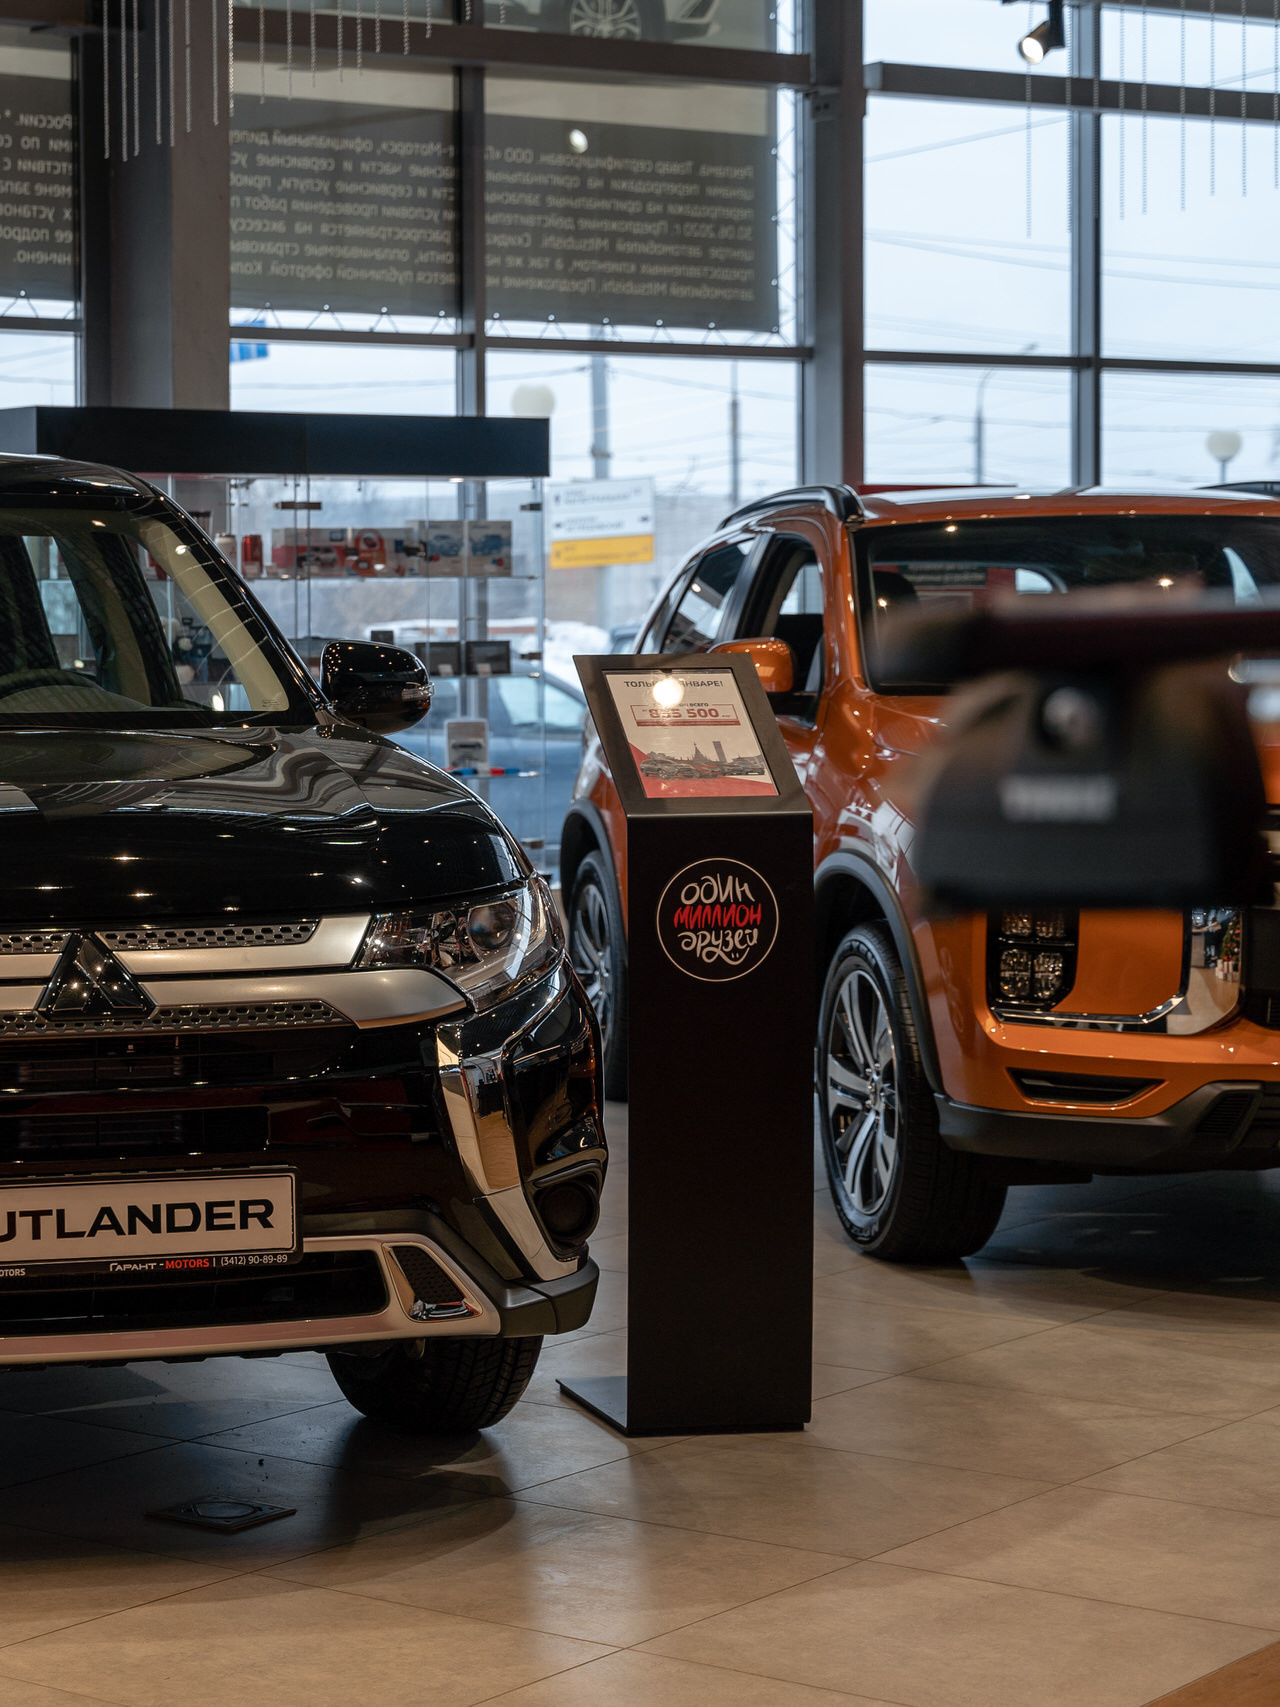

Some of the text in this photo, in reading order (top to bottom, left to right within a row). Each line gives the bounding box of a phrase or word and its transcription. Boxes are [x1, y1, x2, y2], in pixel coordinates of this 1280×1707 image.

[686, 708, 719, 718] 500
[165, 1257, 210, 1270] MOTORS
[220, 1254, 246, 1267] (3412)
[248, 1253, 288, 1266] 90-89-89
